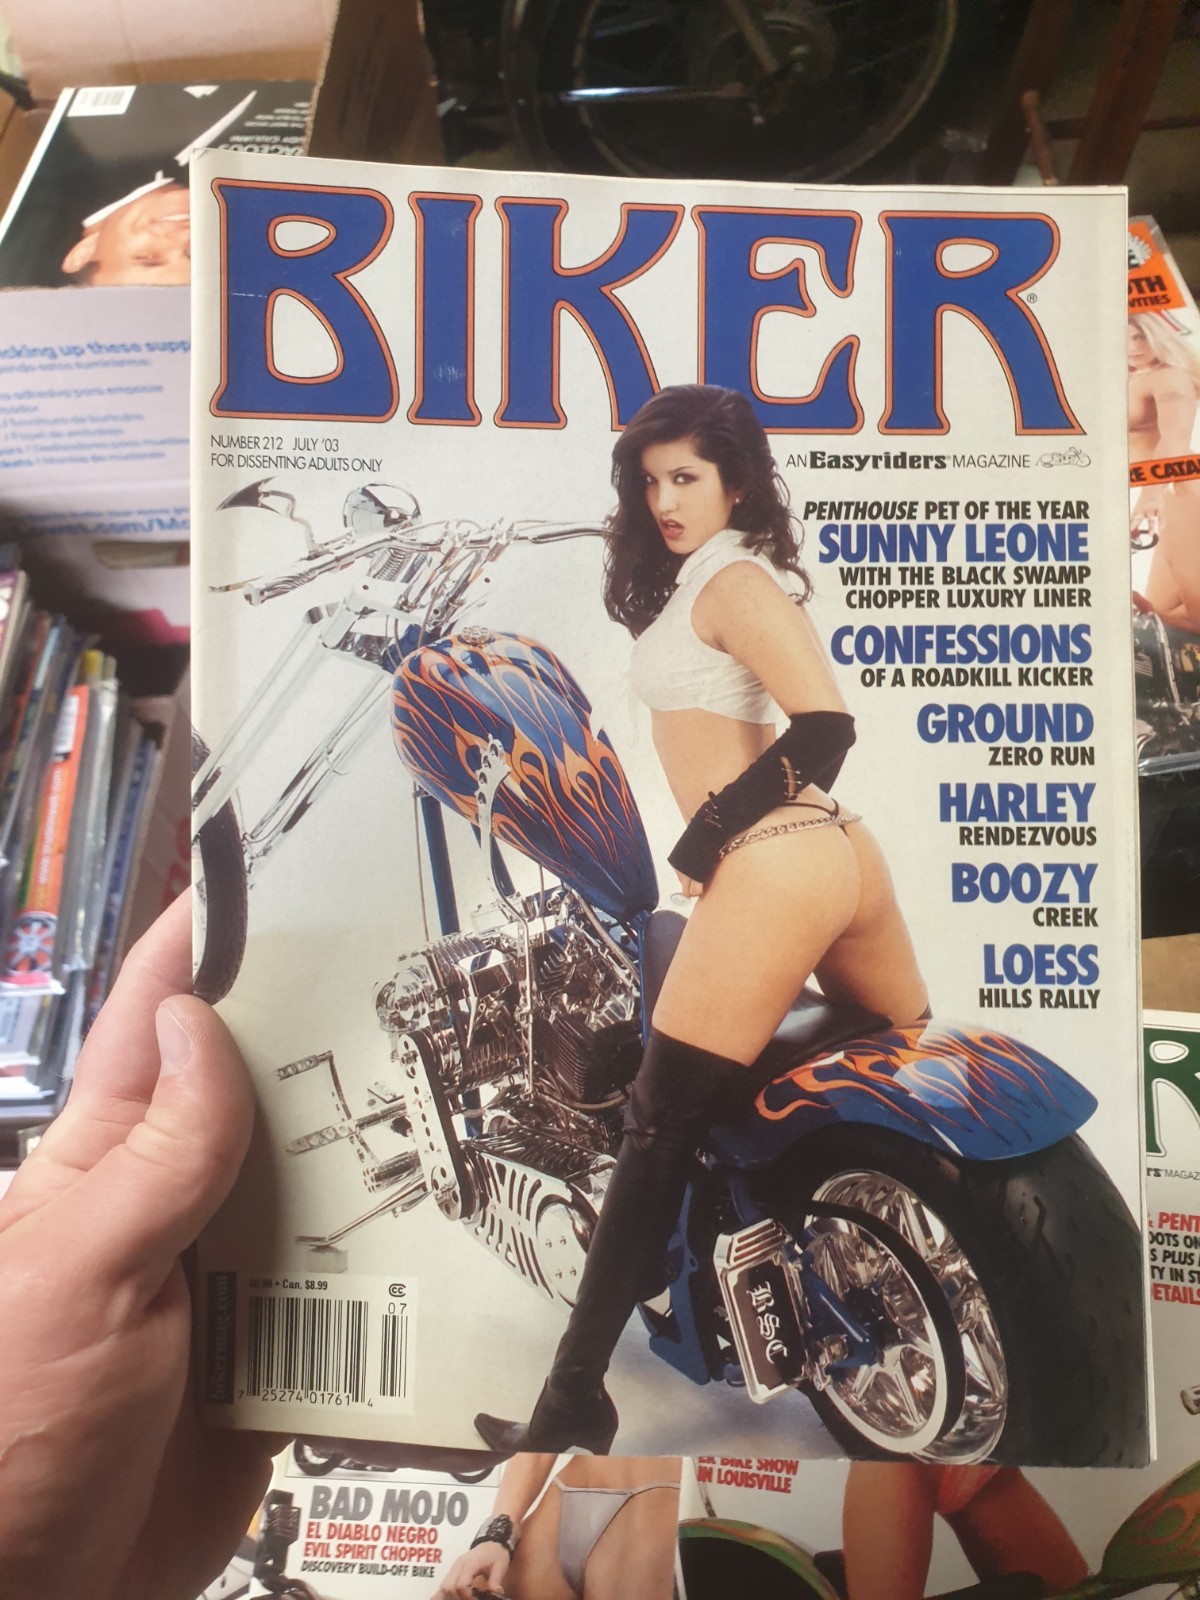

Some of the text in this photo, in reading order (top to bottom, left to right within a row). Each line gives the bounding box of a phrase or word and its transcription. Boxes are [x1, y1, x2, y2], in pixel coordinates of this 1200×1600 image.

[1128, 275, 1167, 294] TH
[210, 177, 1088, 436] BIKER
[211, 435, 339, 452] NUMBER 212 JULY '03
[211, 453, 383, 472] FOR DISSENTING ADULTS ONLY
[786, 451, 1030, 471] AN Easyriders MAGAZINE
[1150, 458, 1200, 480] CATA
[803, 501, 1090, 520] PENTHOUSE PET OF THE YEAR
[818, 523, 1089, 563] SUNNY LEONE
[839, 566, 1091, 585] WITH THE BLACK SWAMP
[845, 589, 1092, 608] CHOPPER LUXURY LINER
[831, 624, 1092, 665] CONFESSIONS
[860, 667, 1094, 687] OF A ROADKILL KICKER
[917, 703, 1094, 743] GROUND
[988, 746, 1095, 766] ZERO RUN
[939, 783, 1096, 822] HARLEY
[959, 826, 1097, 846] RENDEZVOUS
[951, 862, 1098, 903] BOOZY
[1032, 907, 1099, 927] CREEK
[983, 943, 1099, 986] LOESS
[979, 988, 1100, 1009] HILLS RALLY
[1163, 1250, 1195, 1266] PLUS
[1170, 1267, 1184, 1282] IN
[282, 1279, 303, 1290] Can.
[305, 1279, 328, 1291] $8.99
[388, 1302, 407, 1315] 07
[262, 1389, 303, 1402] 25274
[309, 1391, 350, 1406] 01761
[756, 1458, 799, 1475] SHOW
[697, 1466, 792, 1494] IN LOUISVILLE
[309, 1485, 469, 1526] BAD MOJO
[305, 1521, 438, 1545] EL DIABLO NEGRO
[303, 1541, 443, 1564] EVIL SPIRIT CHOPPER
[300, 1560, 435, 1578] DISCOVERY BUILD-OFF BIKE
